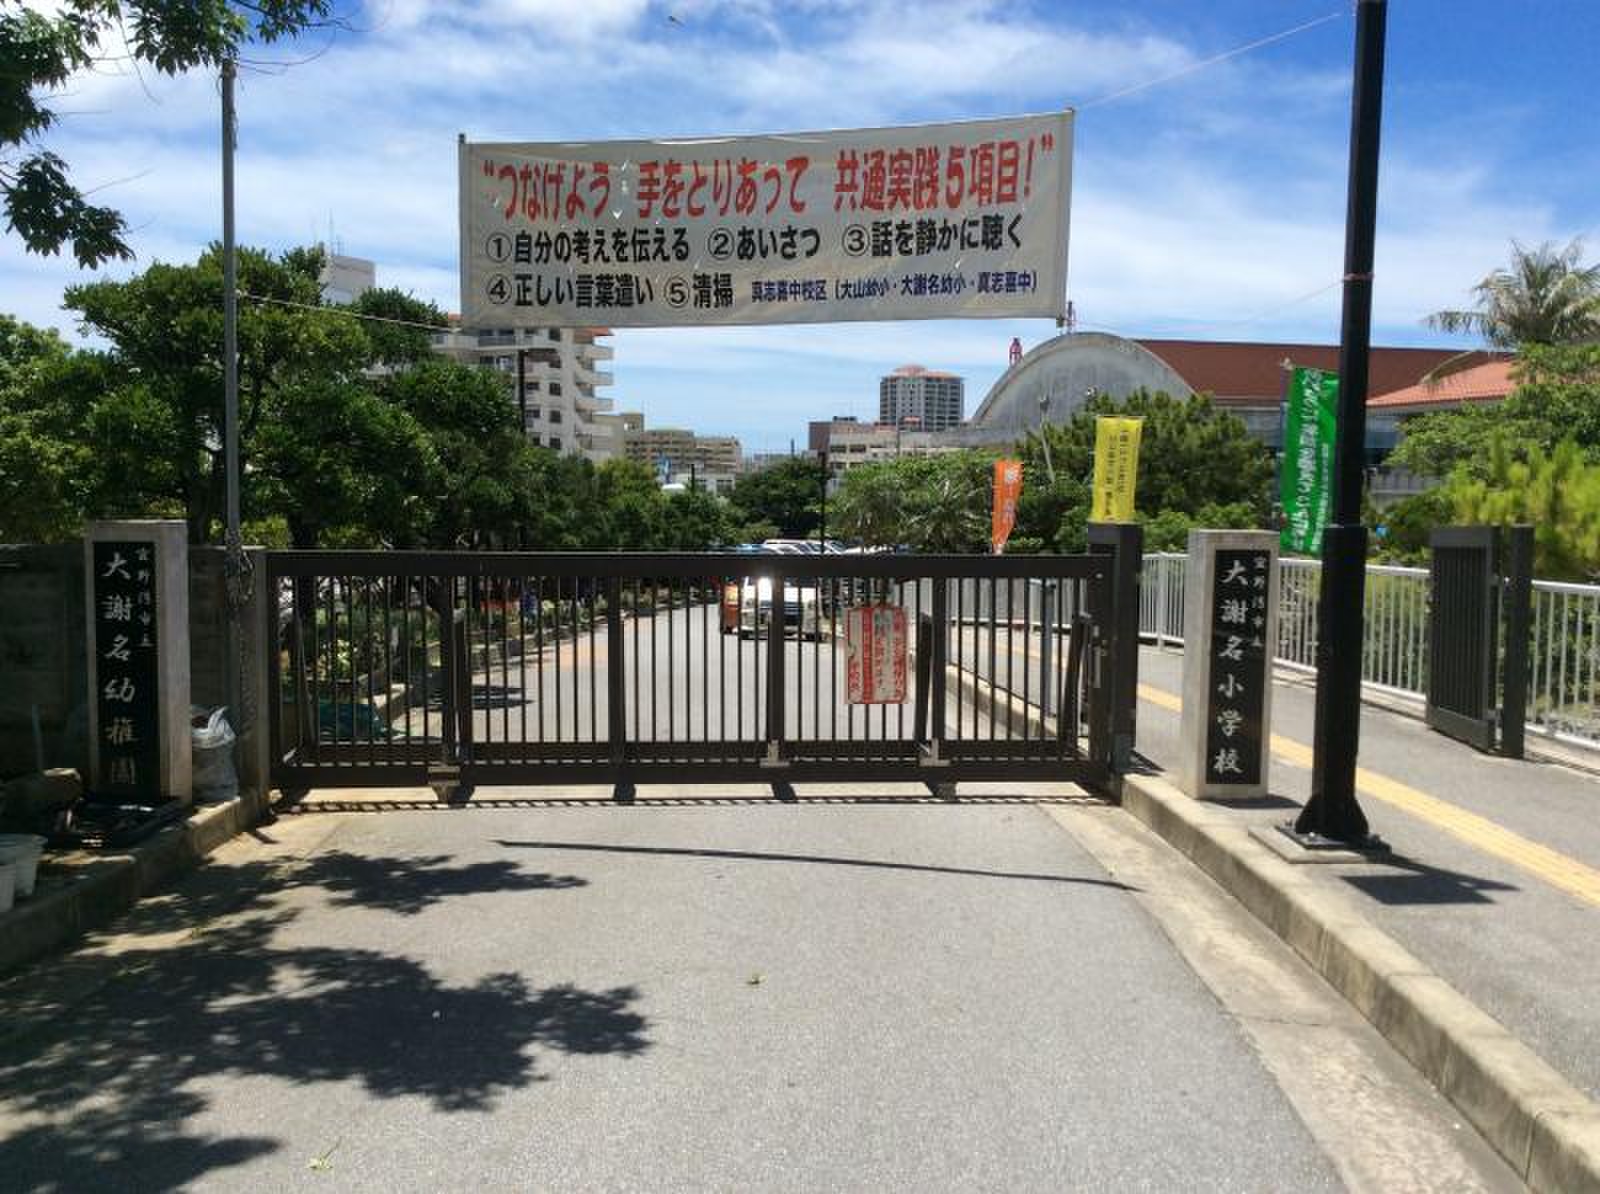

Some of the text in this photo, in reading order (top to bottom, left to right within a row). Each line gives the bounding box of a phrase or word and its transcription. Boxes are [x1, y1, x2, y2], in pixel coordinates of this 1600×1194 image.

[637, 156, 808, 217] 手をとりあって
[708, 225, 820, 260] ②あいさつ
[665, 273, 734, 308] ⑤清掃
[1214, 560, 1249, 774] 大謝名小学校
